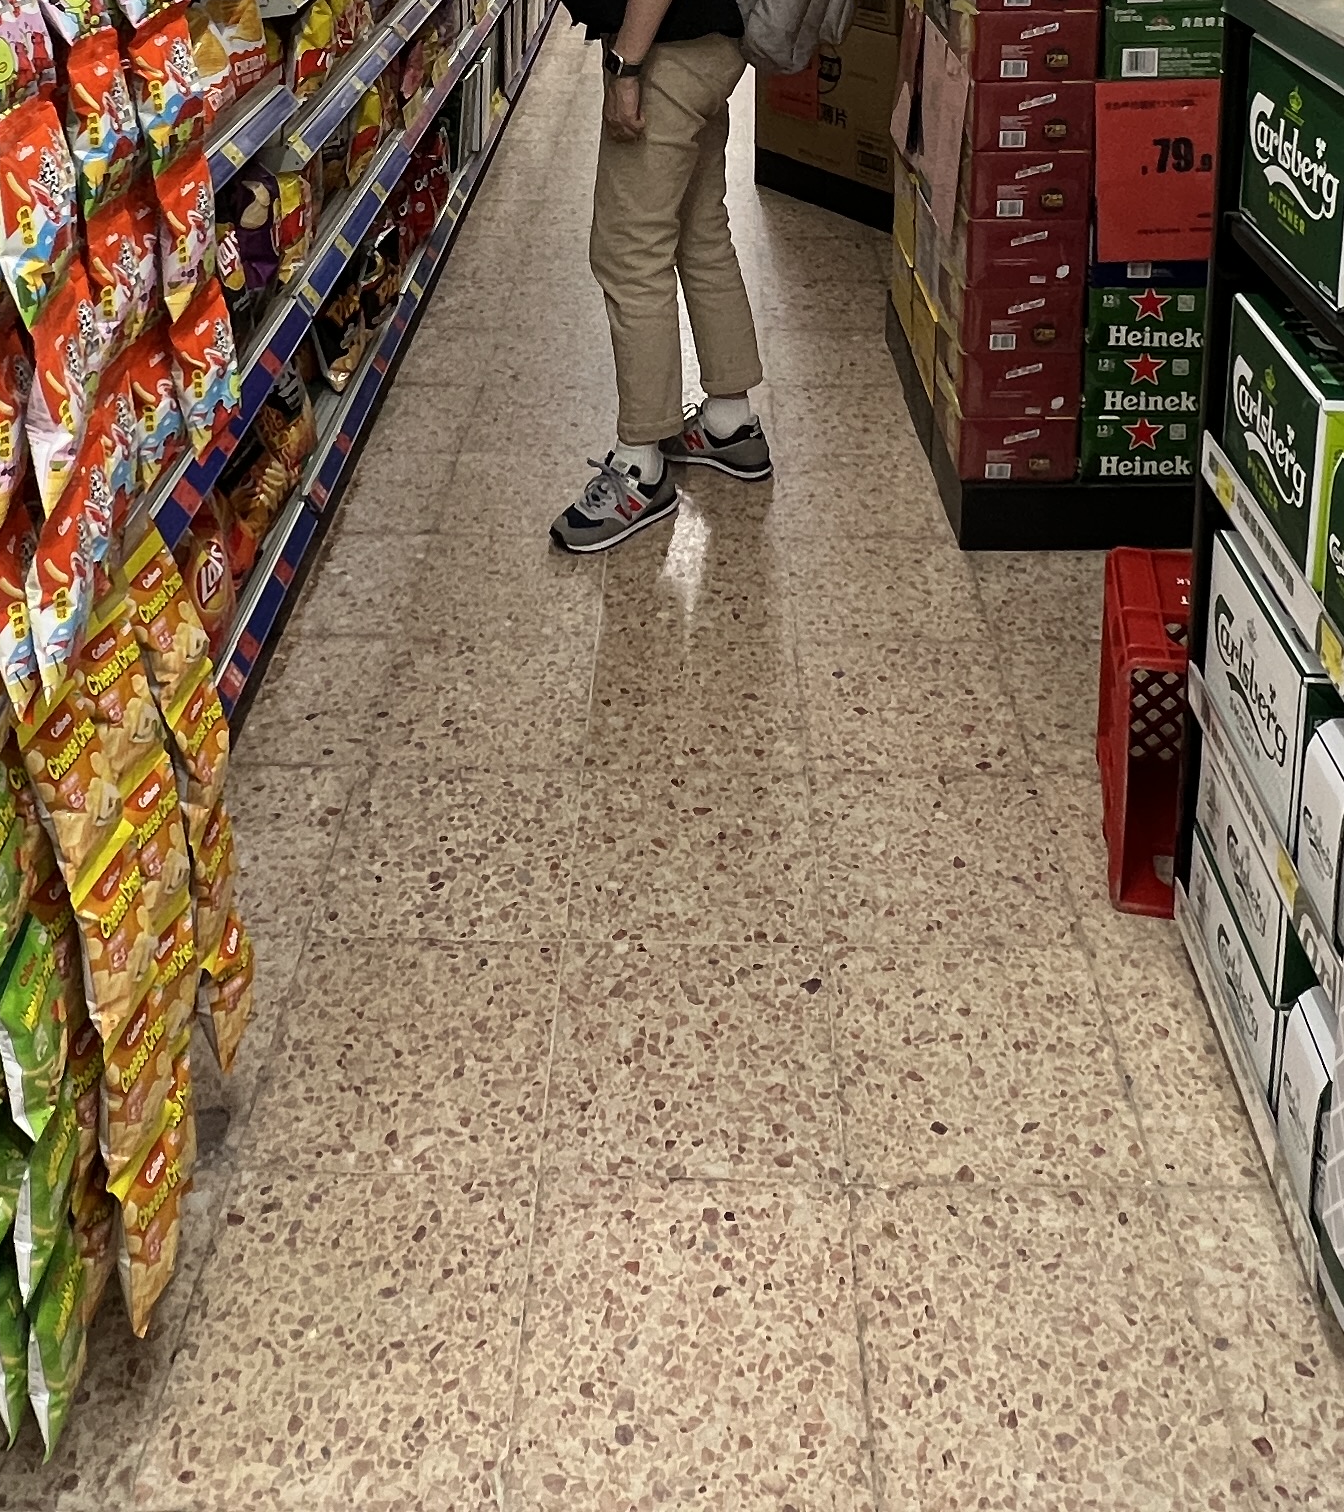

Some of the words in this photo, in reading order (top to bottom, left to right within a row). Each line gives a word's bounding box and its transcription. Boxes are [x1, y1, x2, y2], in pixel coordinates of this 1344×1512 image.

[1249, 92, 1340, 221] Carlsberg
[1268, 191, 1306, 236] PILSNER
[1108, 324, 1204, 349] Heinek
[1103, 389, 1198, 413] Heinek
[1233, 354, 1306, 509] Carlsberg
[1099, 456, 1193, 477] Heinek
[138, 594, 170, 624] Cheese
[86, 662, 123, 697] Cheese
[1214, 593, 1288, 768] Carlsberg
[46, 741, 81, 782] Cheese
